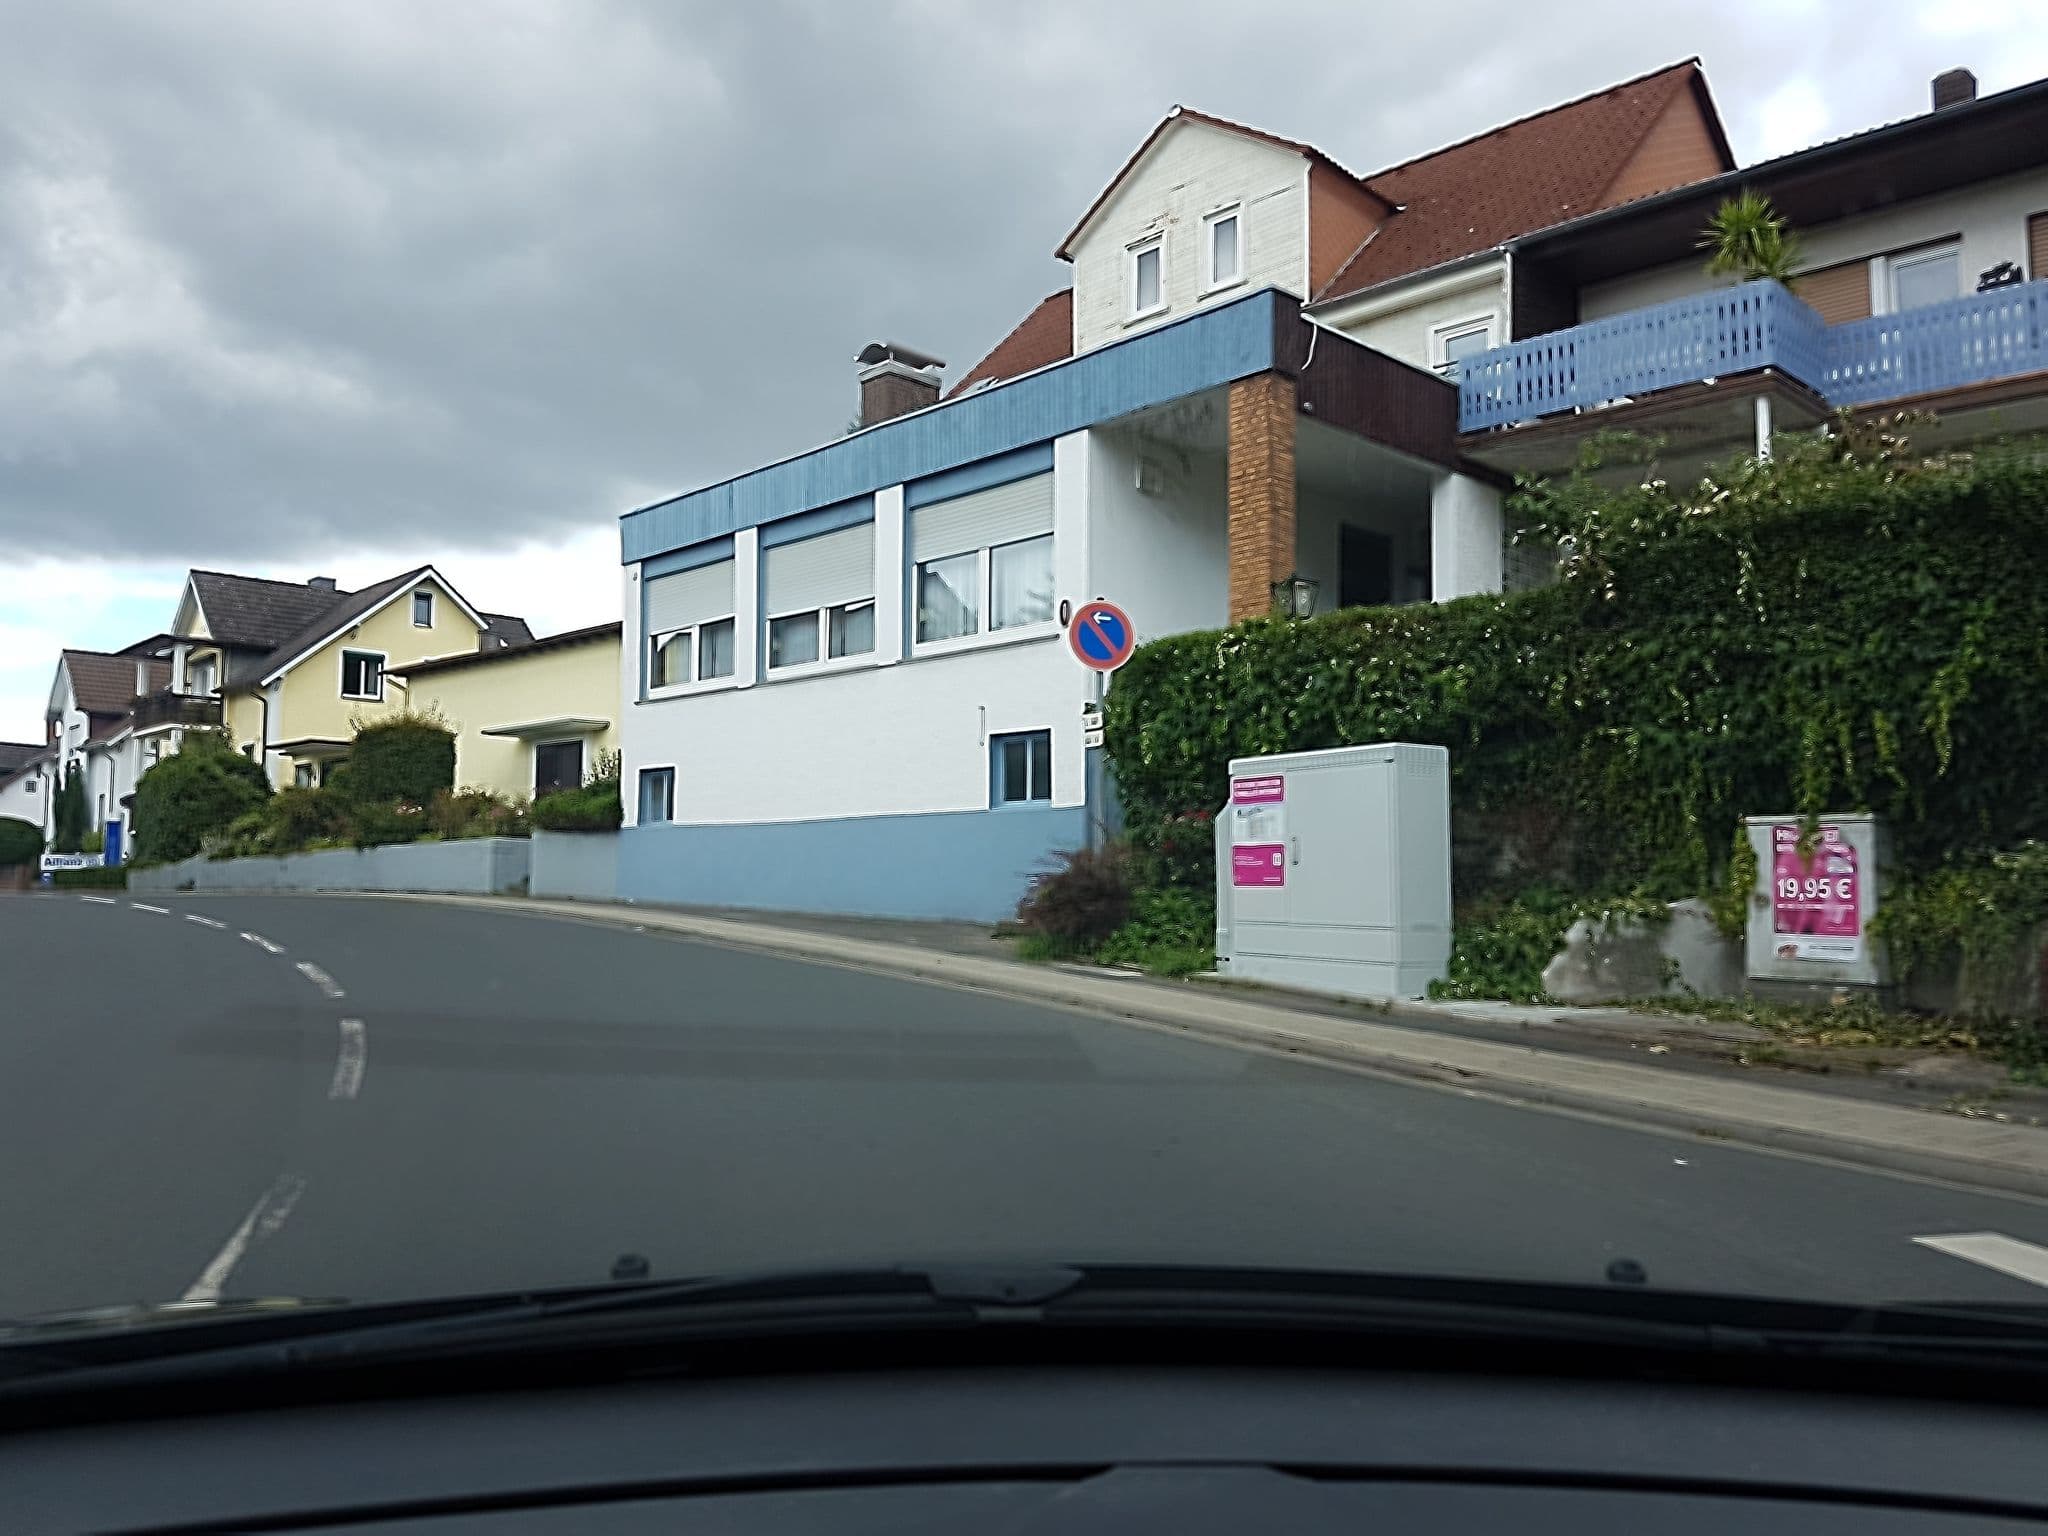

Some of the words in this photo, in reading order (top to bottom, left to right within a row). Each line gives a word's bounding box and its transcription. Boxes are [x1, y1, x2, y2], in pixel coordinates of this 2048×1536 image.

[44, 857, 82, 867] Allianz
[1777, 878, 1832, 901] 19,95
[1835, 878, 1852, 900] €
